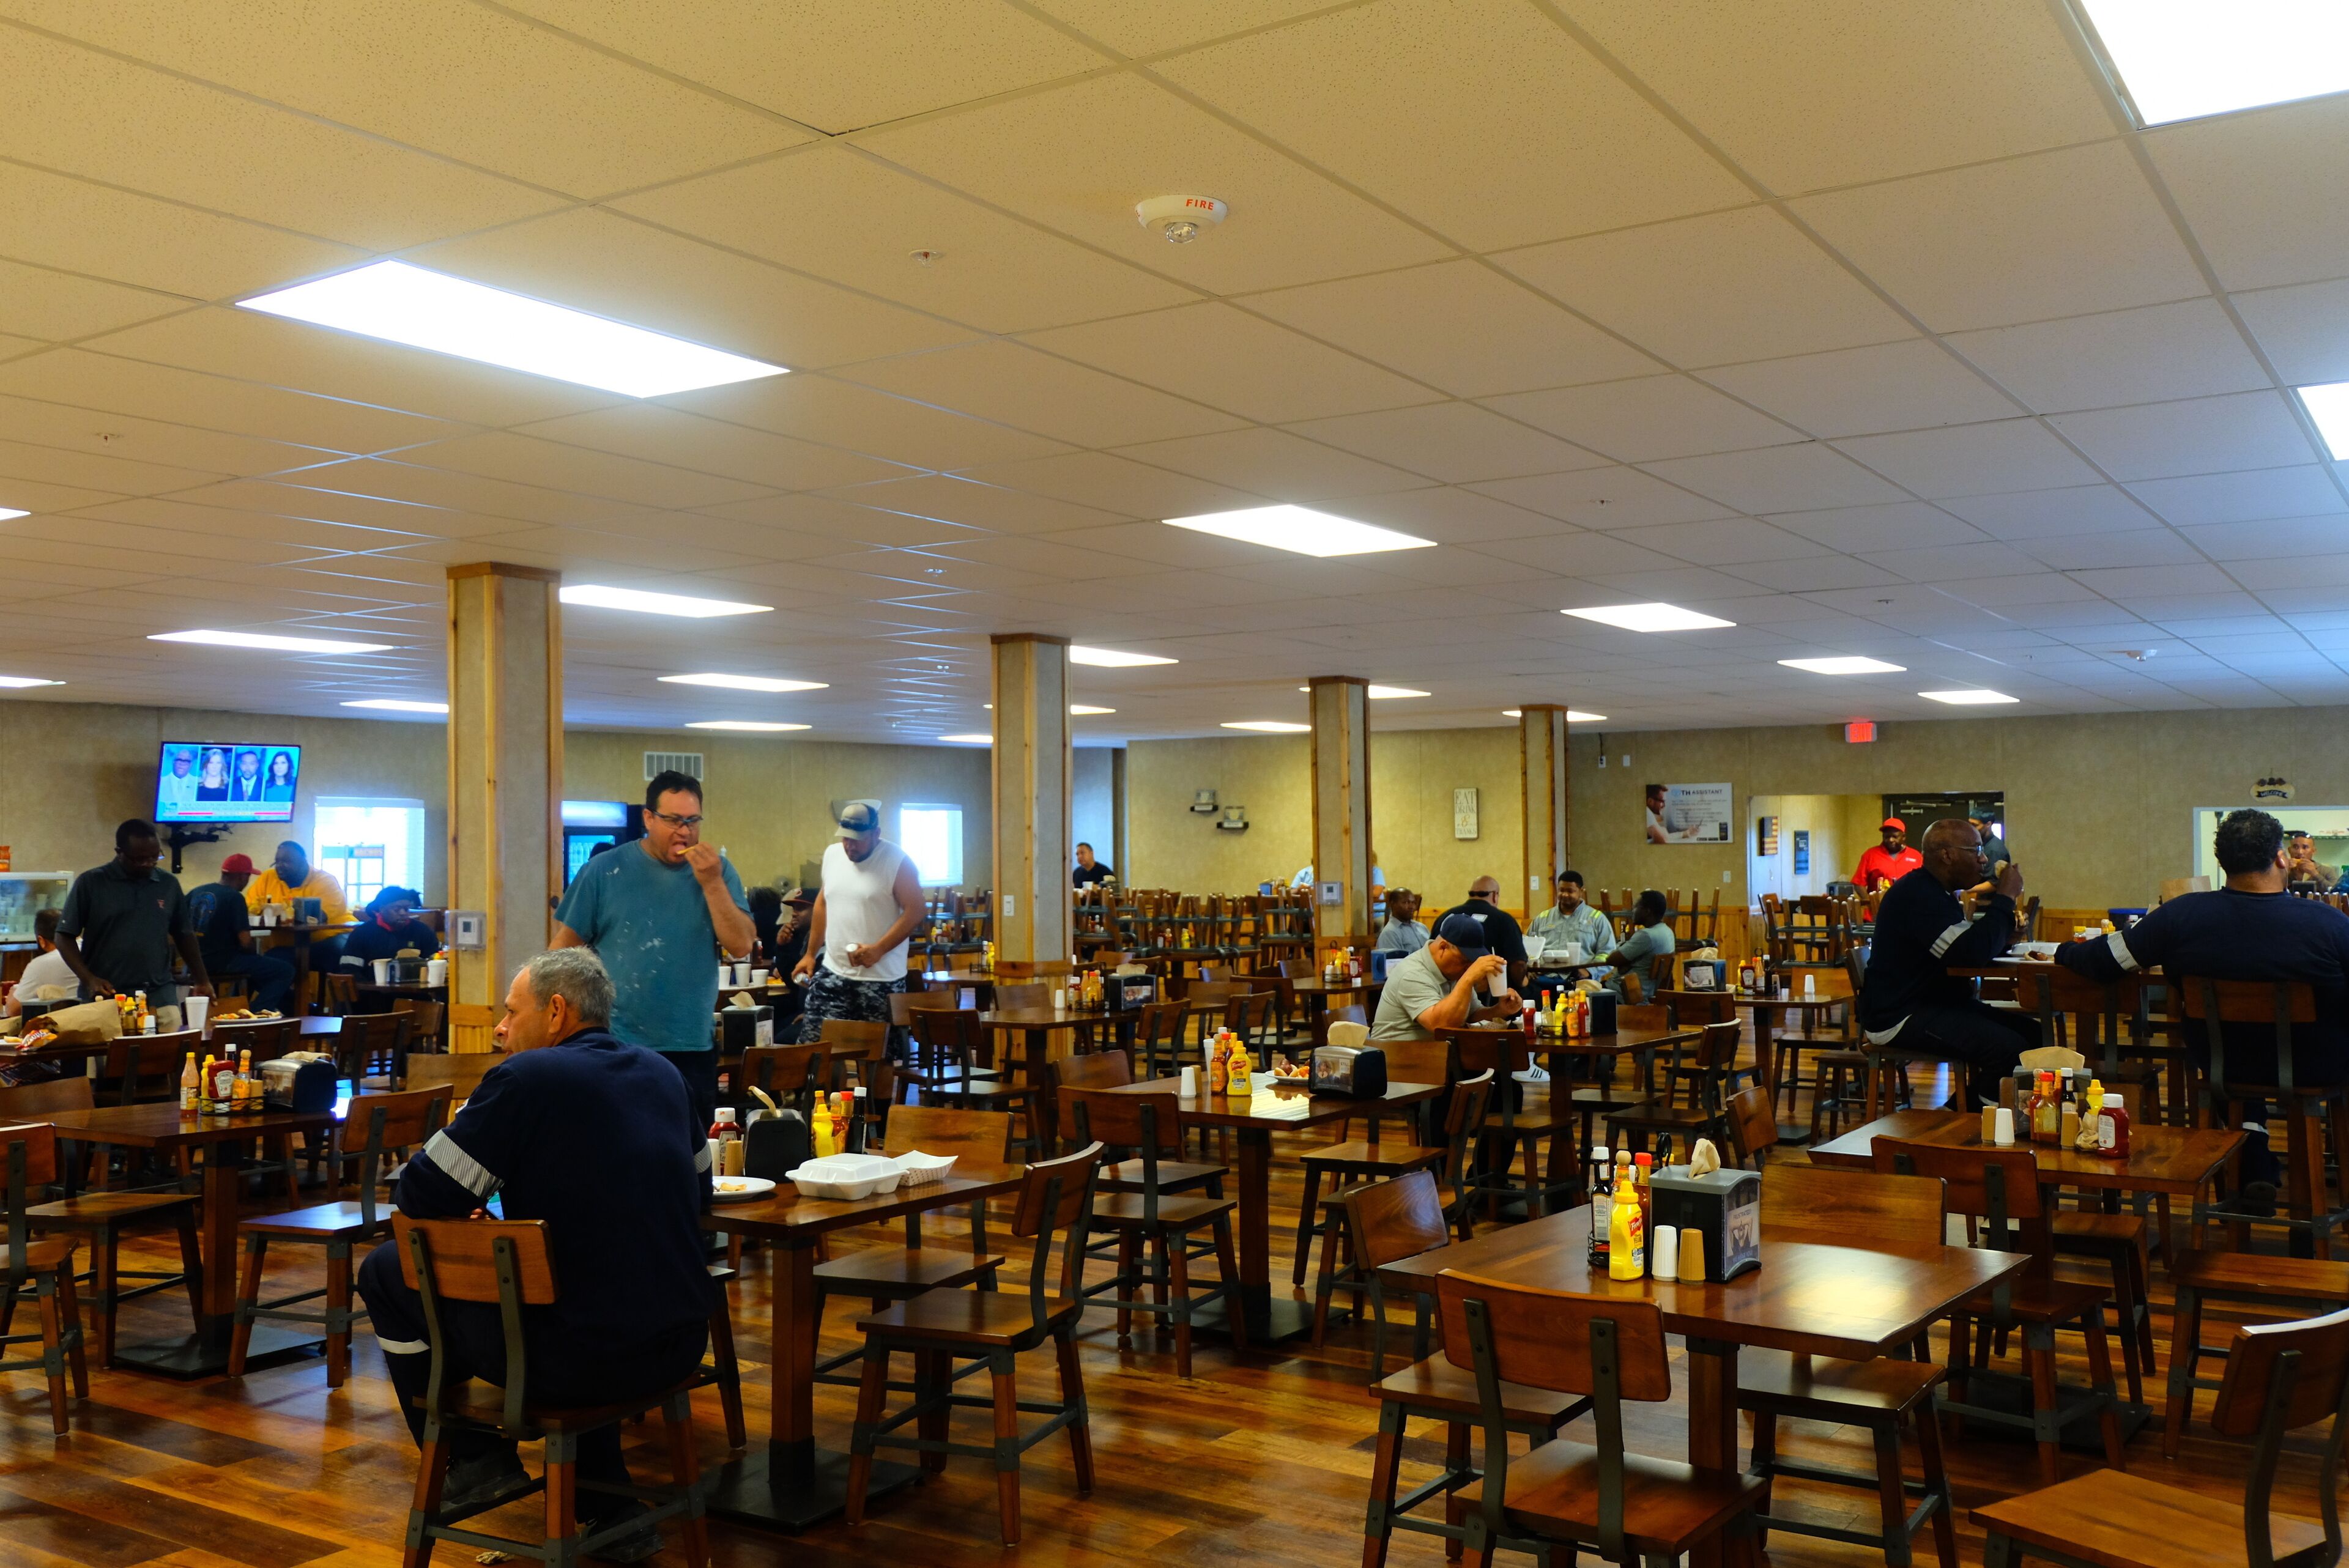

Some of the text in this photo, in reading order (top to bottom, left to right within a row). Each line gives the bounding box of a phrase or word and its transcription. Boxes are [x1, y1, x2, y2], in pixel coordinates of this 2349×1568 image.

[1186, 199, 1214, 211] FIRE
[1455, 791, 1476, 804] EAT
[1455, 805, 1476, 814] DRINK
